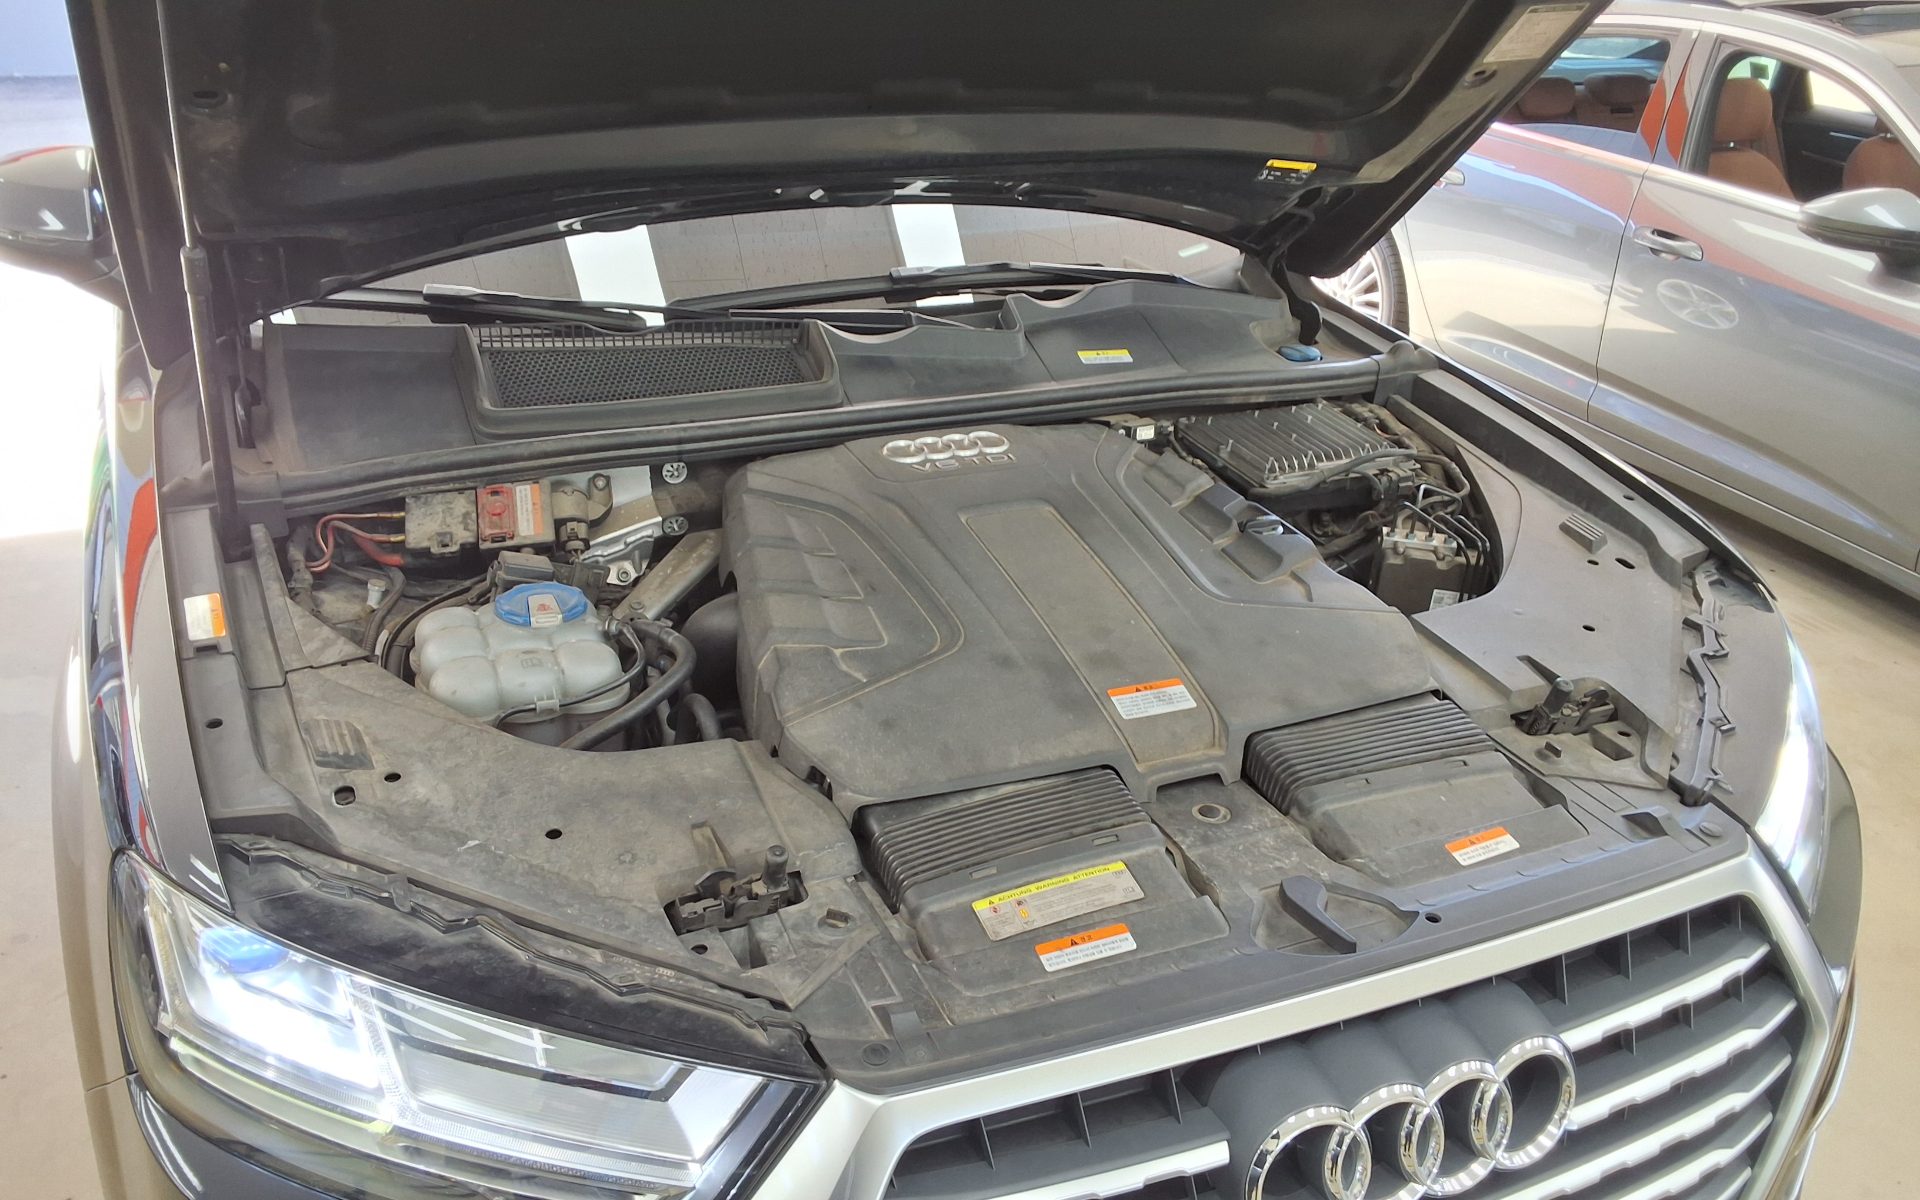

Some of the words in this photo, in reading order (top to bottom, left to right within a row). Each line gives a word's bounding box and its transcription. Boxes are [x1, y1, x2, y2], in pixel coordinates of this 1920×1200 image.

[911, 459, 959, 472] V6
[963, 453, 1017, 465] TDI
[998, 887, 1032, 902] ACHTUNG
[1035, 877, 1070, 891] WARNING
[1073, 866, 1110, 880] ATTENTION
